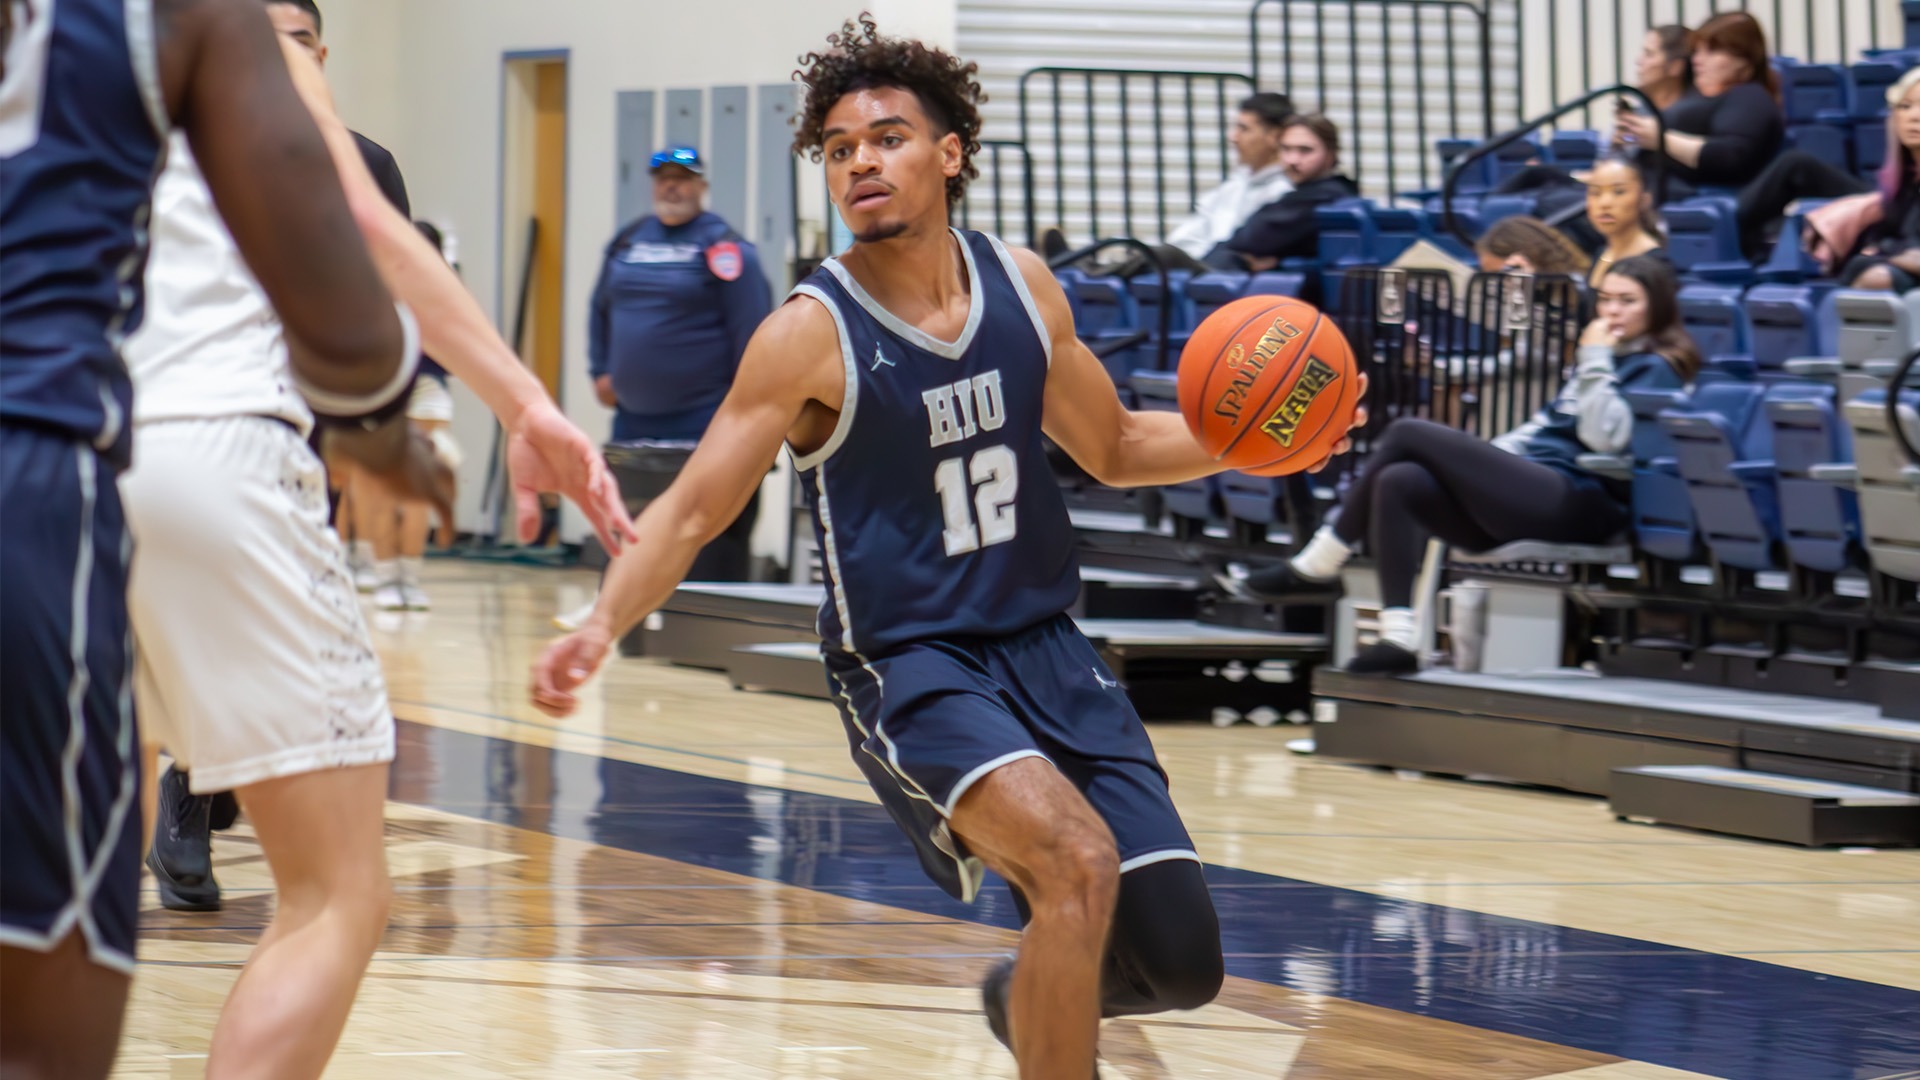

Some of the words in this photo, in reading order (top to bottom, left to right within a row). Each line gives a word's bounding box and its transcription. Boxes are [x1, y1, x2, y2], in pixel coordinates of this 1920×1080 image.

[921, 369, 1006, 448] HIU
[1214, 316, 1303, 426] SPALDING
[934, 444, 1018, 557] 12
